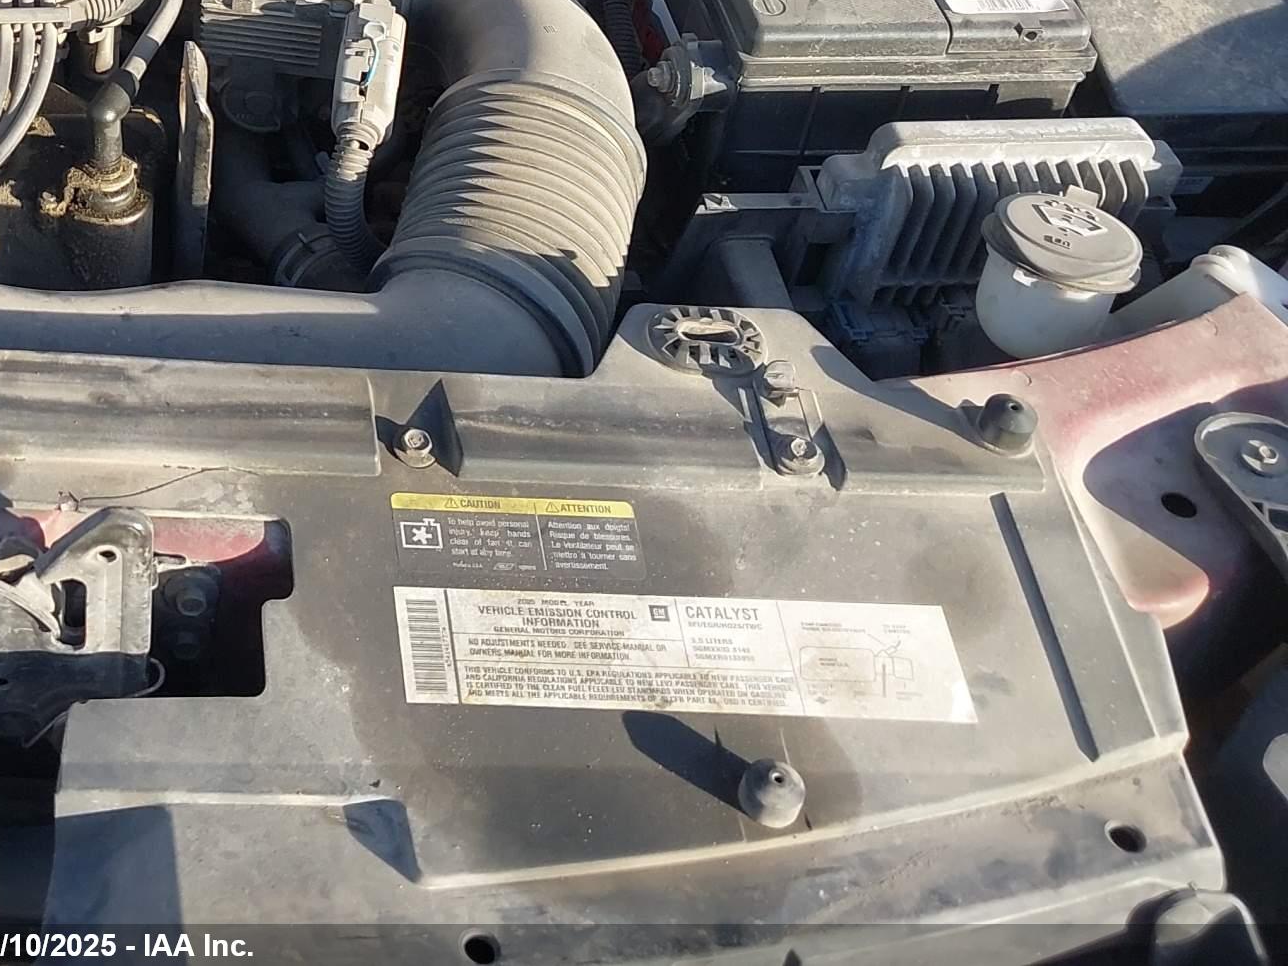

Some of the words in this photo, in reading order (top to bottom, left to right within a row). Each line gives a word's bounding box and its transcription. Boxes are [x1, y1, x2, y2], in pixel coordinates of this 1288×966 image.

[460, 499, 501, 509] CAUTION
[560, 503, 612, 514] ATTENTION
[497, 520, 530, 529] personal
[548, 521, 582, 530] Attention
[586, 523, 600, 531] aux
[507, 529, 531, 538] hands
[579, 532, 590, 540] de
[477, 605, 524, 616] VEHICLE
[527, 607, 582, 618] EMISSION
[585, 609, 638, 620] CONTROL
[684, 605, 759, 621] CATALYST
[522, 617, 600, 628] INFORMATION
[493, 626, 530, 634] GENERAL
[532, 627, 566, 635] MOTORS
[468, 637, 479, 646] NO
[480, 638, 535, 647] ADJUSTMENTS
[503, 648, 535, 658] MANUAL
[537, 650, 553, 658] FOR
[554, 650, 577, 659] MORE
[481, 666, 513, 675] VEHICLE
[514, 667, 556, 676] CONFORMS
